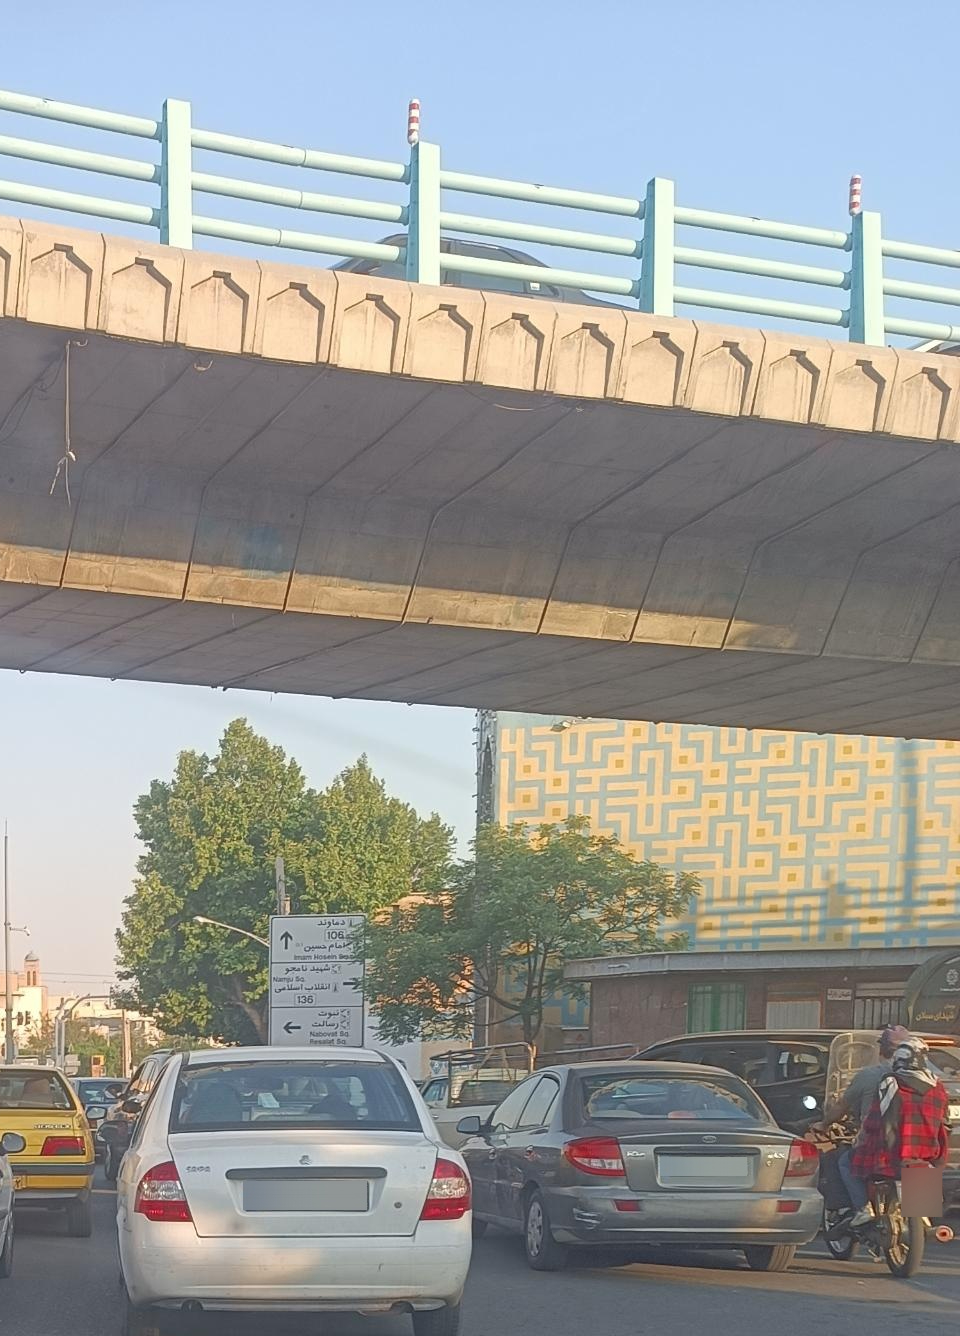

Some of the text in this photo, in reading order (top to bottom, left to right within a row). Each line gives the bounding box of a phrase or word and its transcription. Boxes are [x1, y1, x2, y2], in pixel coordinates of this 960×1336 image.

[317, 919, 346, 929] دماوند
[327, 930, 345, 940] 106
[303, 943, 328, 952] حسین
[328, 942, 346, 952] امام
[314, 953, 338, 961] Hosein
[284, 964, 331, 975] شهید نامجو
[274, 983, 331, 994] انقلاب اسلامی
[297, 995, 314, 1004] 136
[317, 1009, 340, 1020] نبوت
[311, 1020, 339, 1030] رسالت
